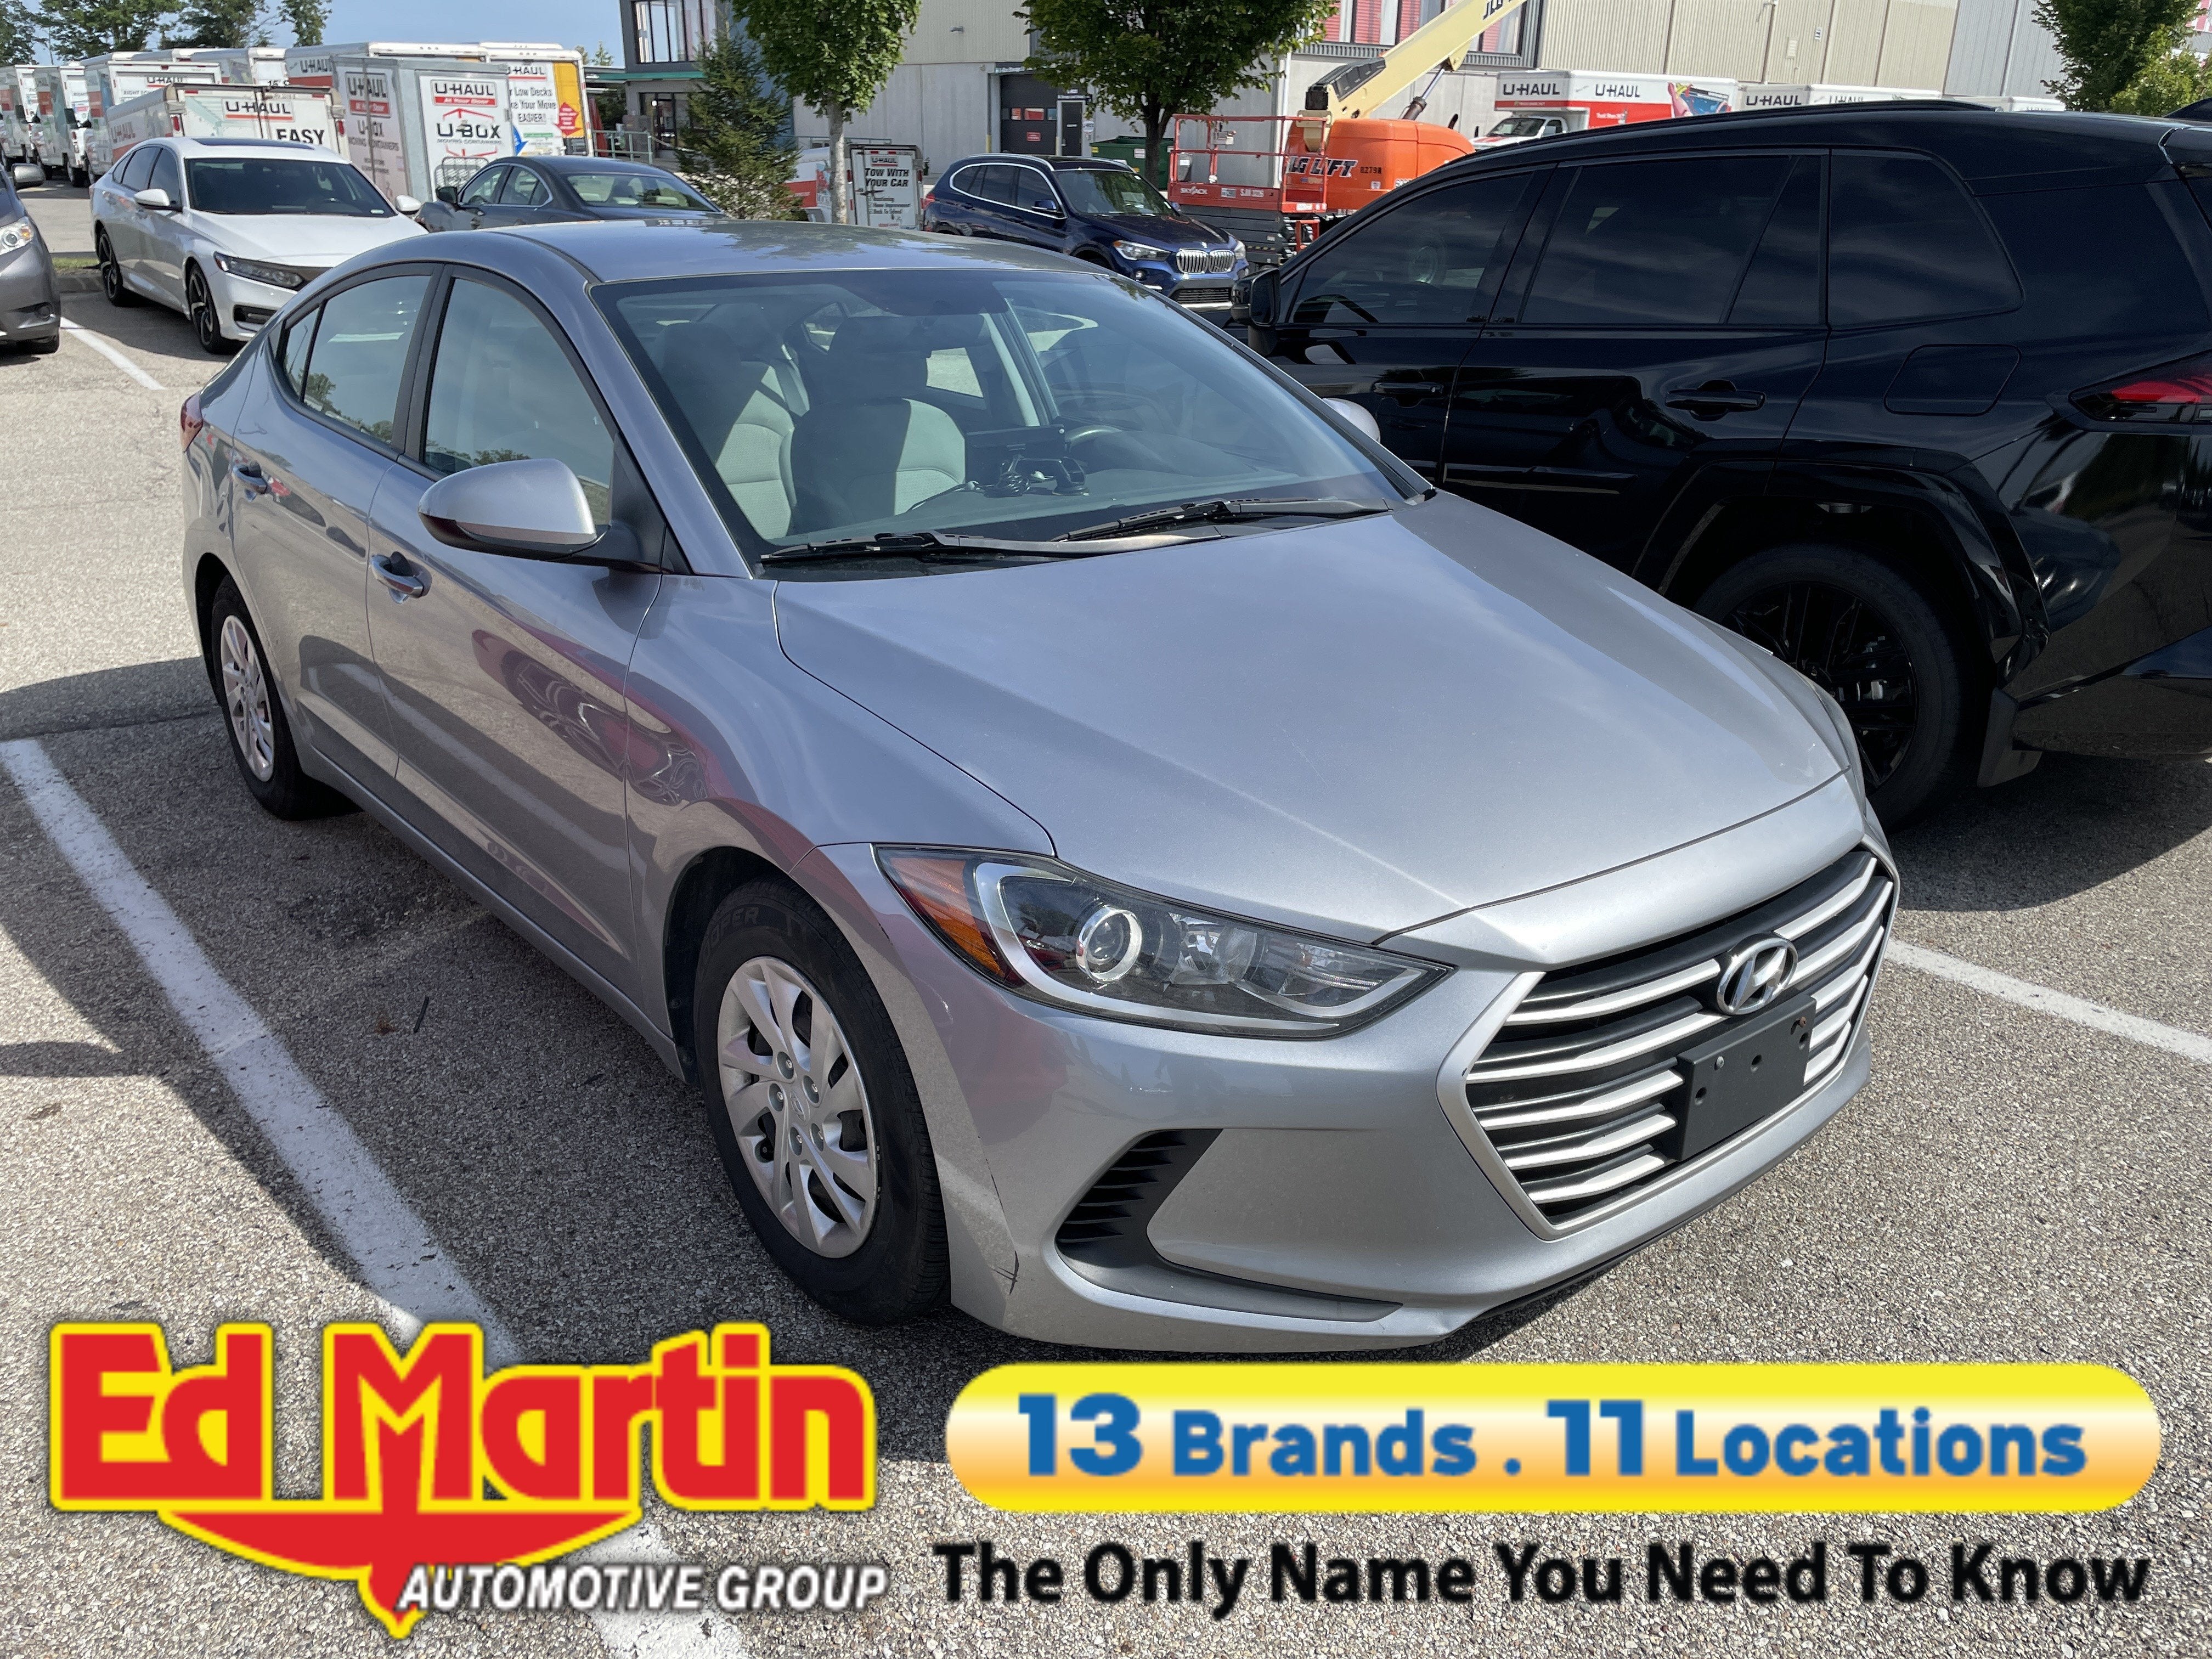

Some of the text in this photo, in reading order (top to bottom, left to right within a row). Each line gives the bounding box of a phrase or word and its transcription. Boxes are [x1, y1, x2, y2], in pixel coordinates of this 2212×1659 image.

[435, 83, 494, 96] U-HAUL
[1503, 83, 1560, 96] U-HAUL
[1595, 84, 1640, 98] U-HAUL
[1746, 95, 1802, 106] U-HAUL
[225, 101, 291, 114] U-HAUL
[276, 128, 325, 145] EASY
[437, 122, 501, 139] U-BOX
[865, 168, 909, 177] TOW WITH
[1309, 157, 1359, 178] LIFT
[866, 178, 909, 187] YOUR CAR
